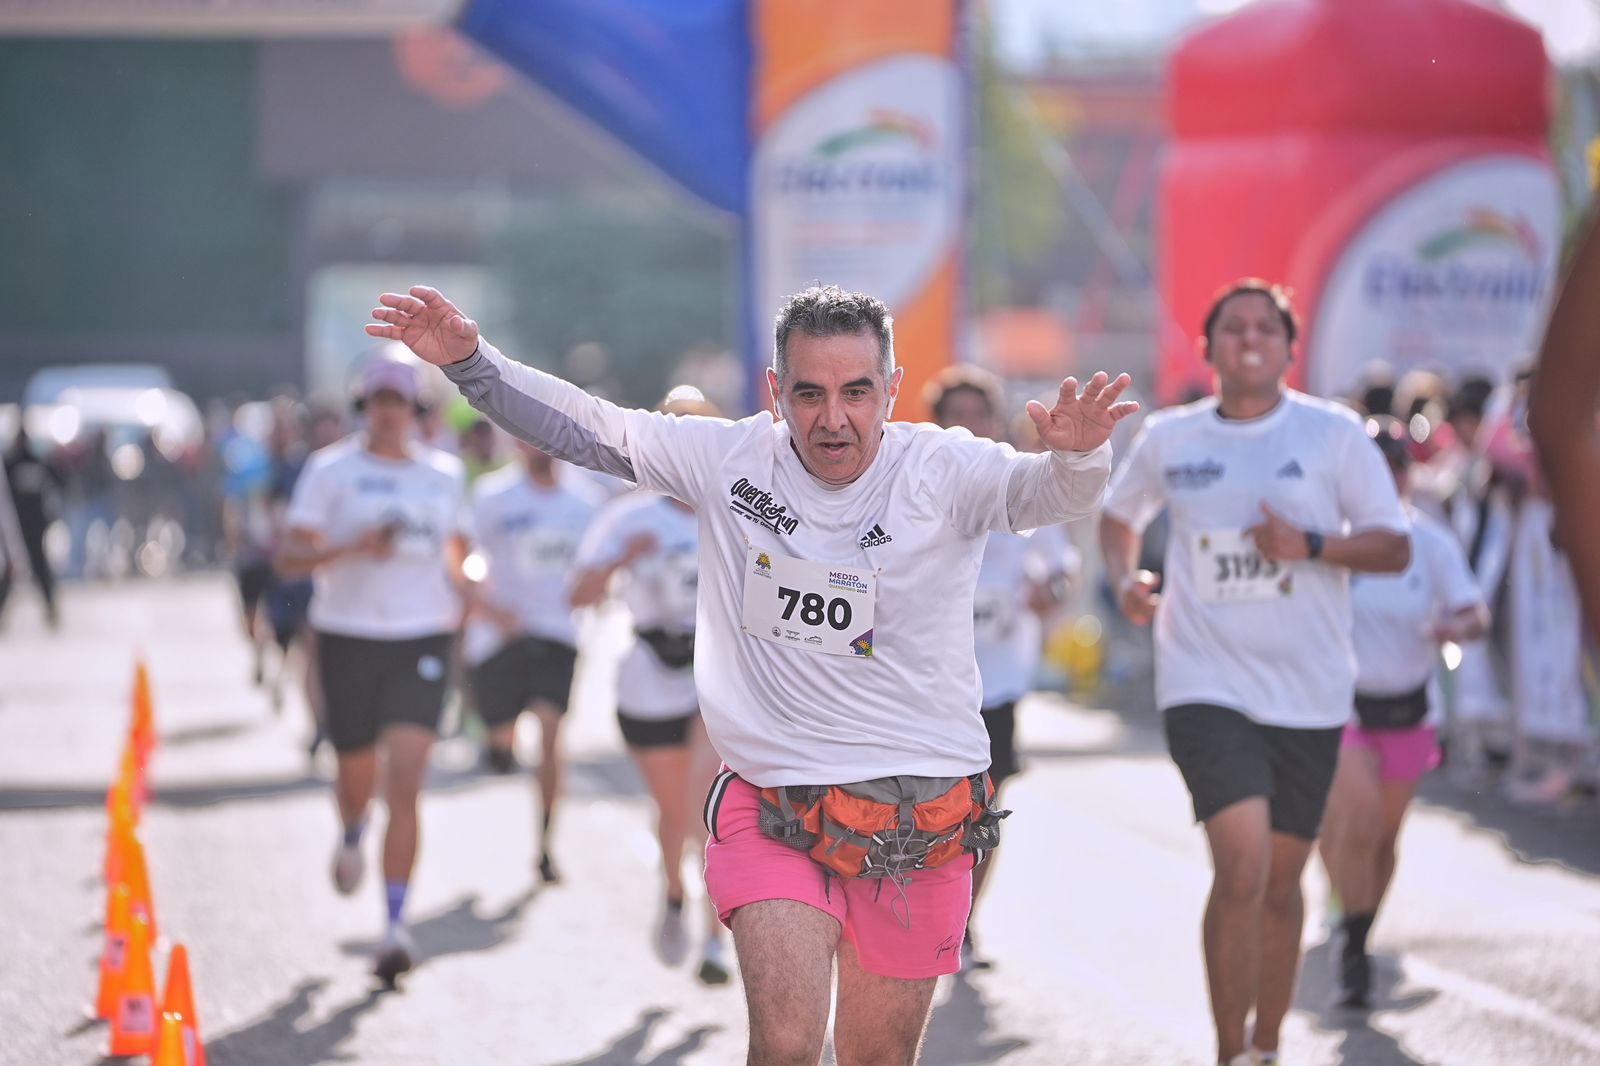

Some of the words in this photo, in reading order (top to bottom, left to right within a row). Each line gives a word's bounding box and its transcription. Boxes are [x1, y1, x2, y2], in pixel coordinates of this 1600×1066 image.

[829, 571, 859, 582] MEDIO
[829, 578, 868, 590] MARATÓN
[777, 586, 852, 631] 780
